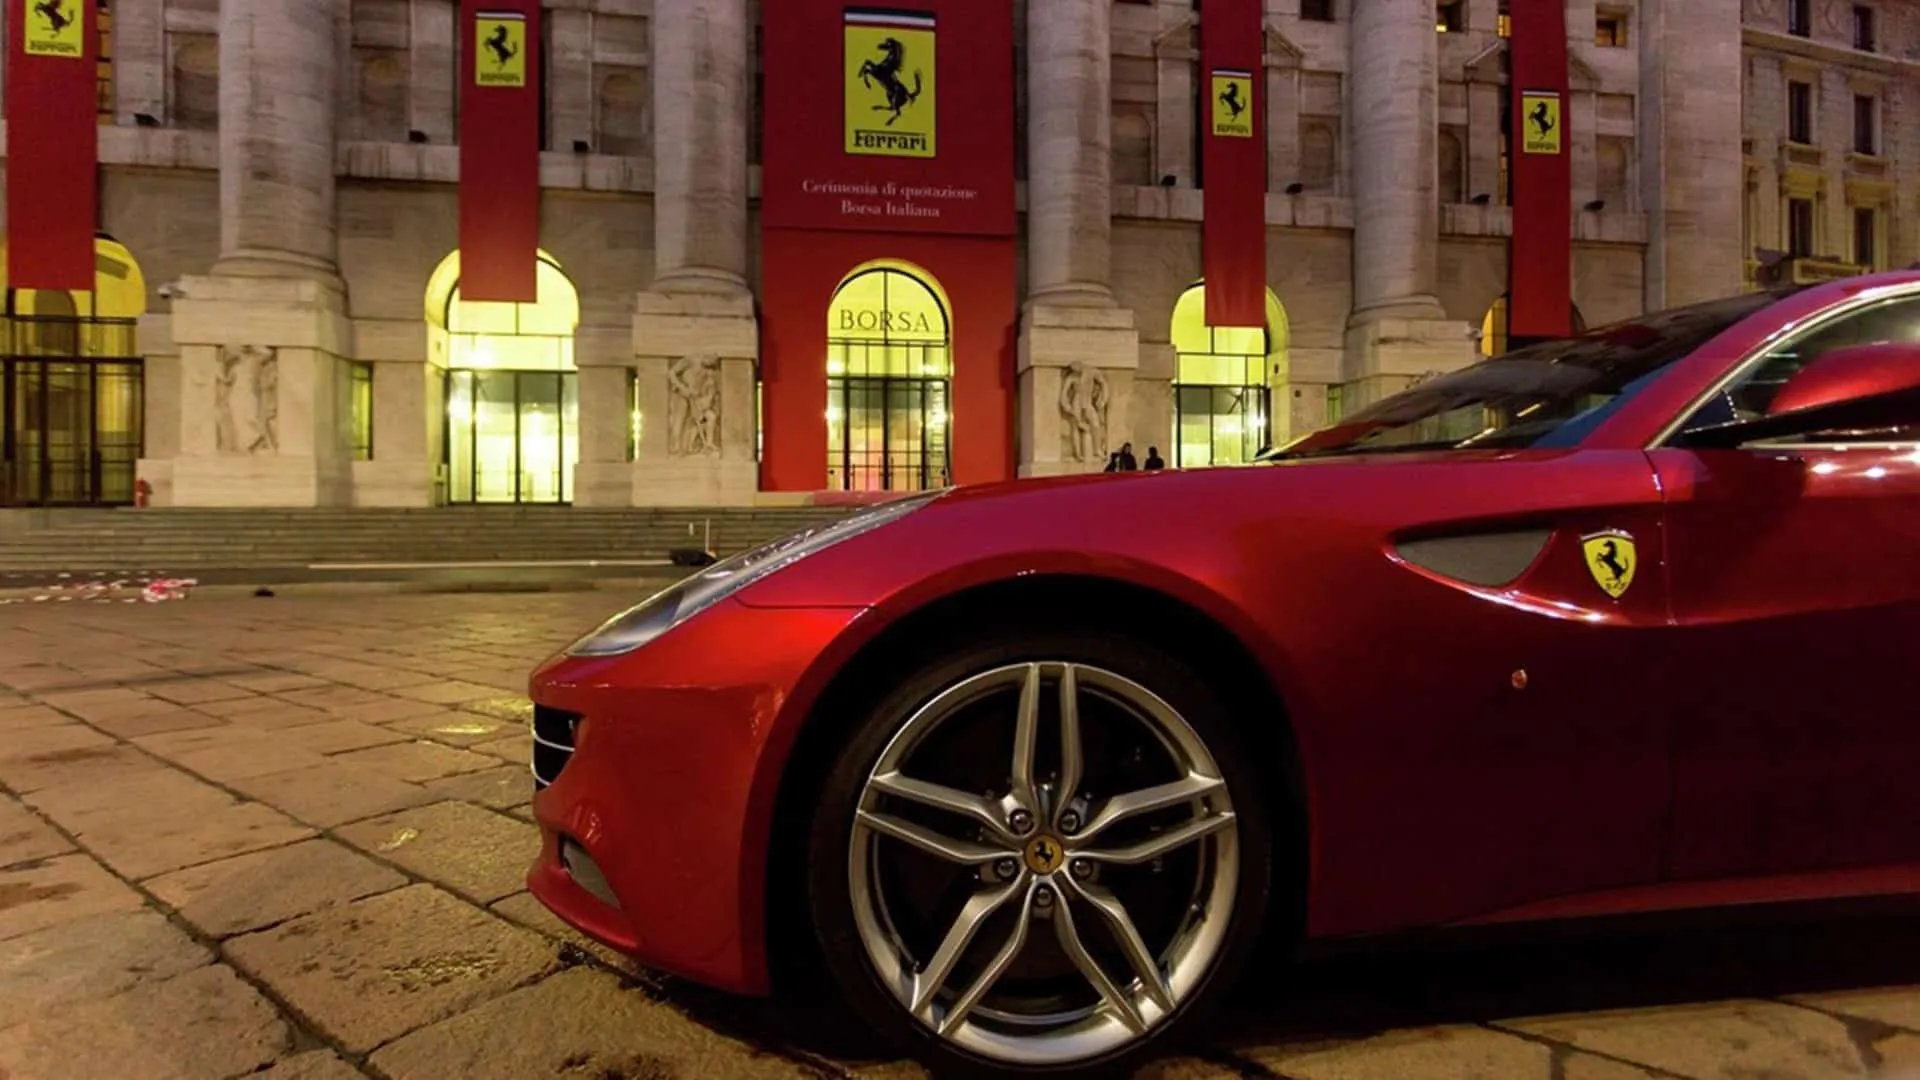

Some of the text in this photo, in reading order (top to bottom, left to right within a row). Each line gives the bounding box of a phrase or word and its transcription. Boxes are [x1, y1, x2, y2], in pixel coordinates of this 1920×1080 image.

[853, 129, 927, 151] Ferrari
[802, 179, 977, 200] Cerimonia di quotazione
[841, 199, 940, 217] Borsa Italiana
[840, 308, 929, 332] BORSA
